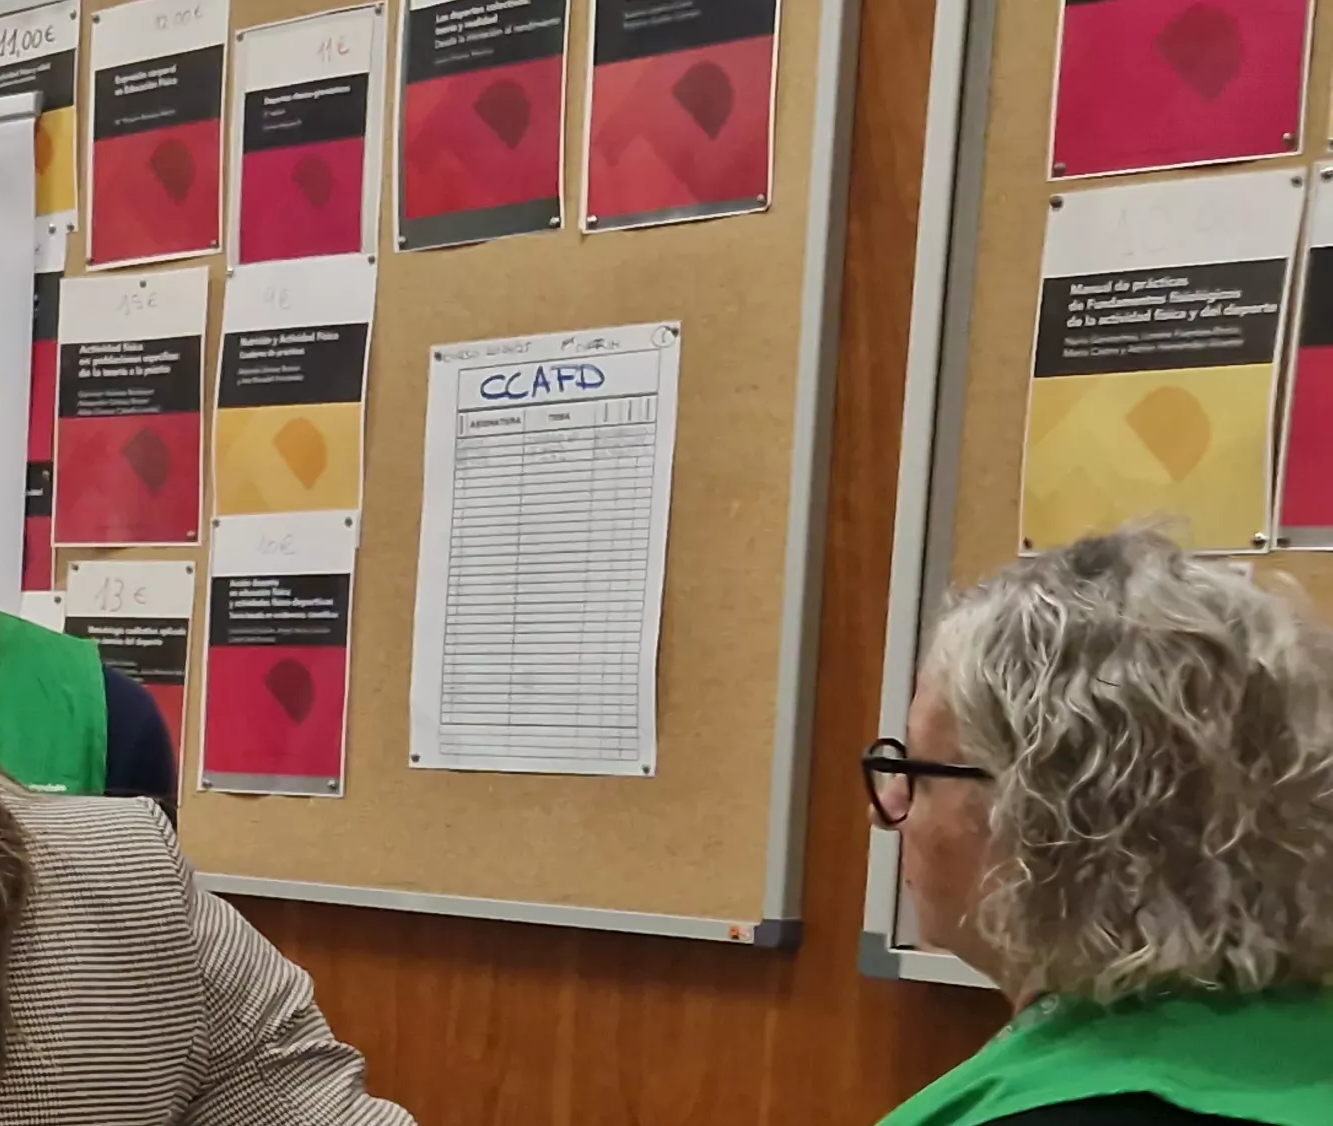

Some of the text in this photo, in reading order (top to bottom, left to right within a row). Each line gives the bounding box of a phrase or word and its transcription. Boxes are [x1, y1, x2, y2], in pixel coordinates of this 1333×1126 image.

[1070, 280, 1113, 295] Manual
[1114, 279, 1130, 292] de
[1068, 298, 1084, 312] de
[1067, 315, 1083, 328] de
[480, 363, 605, 400] CCAFD
